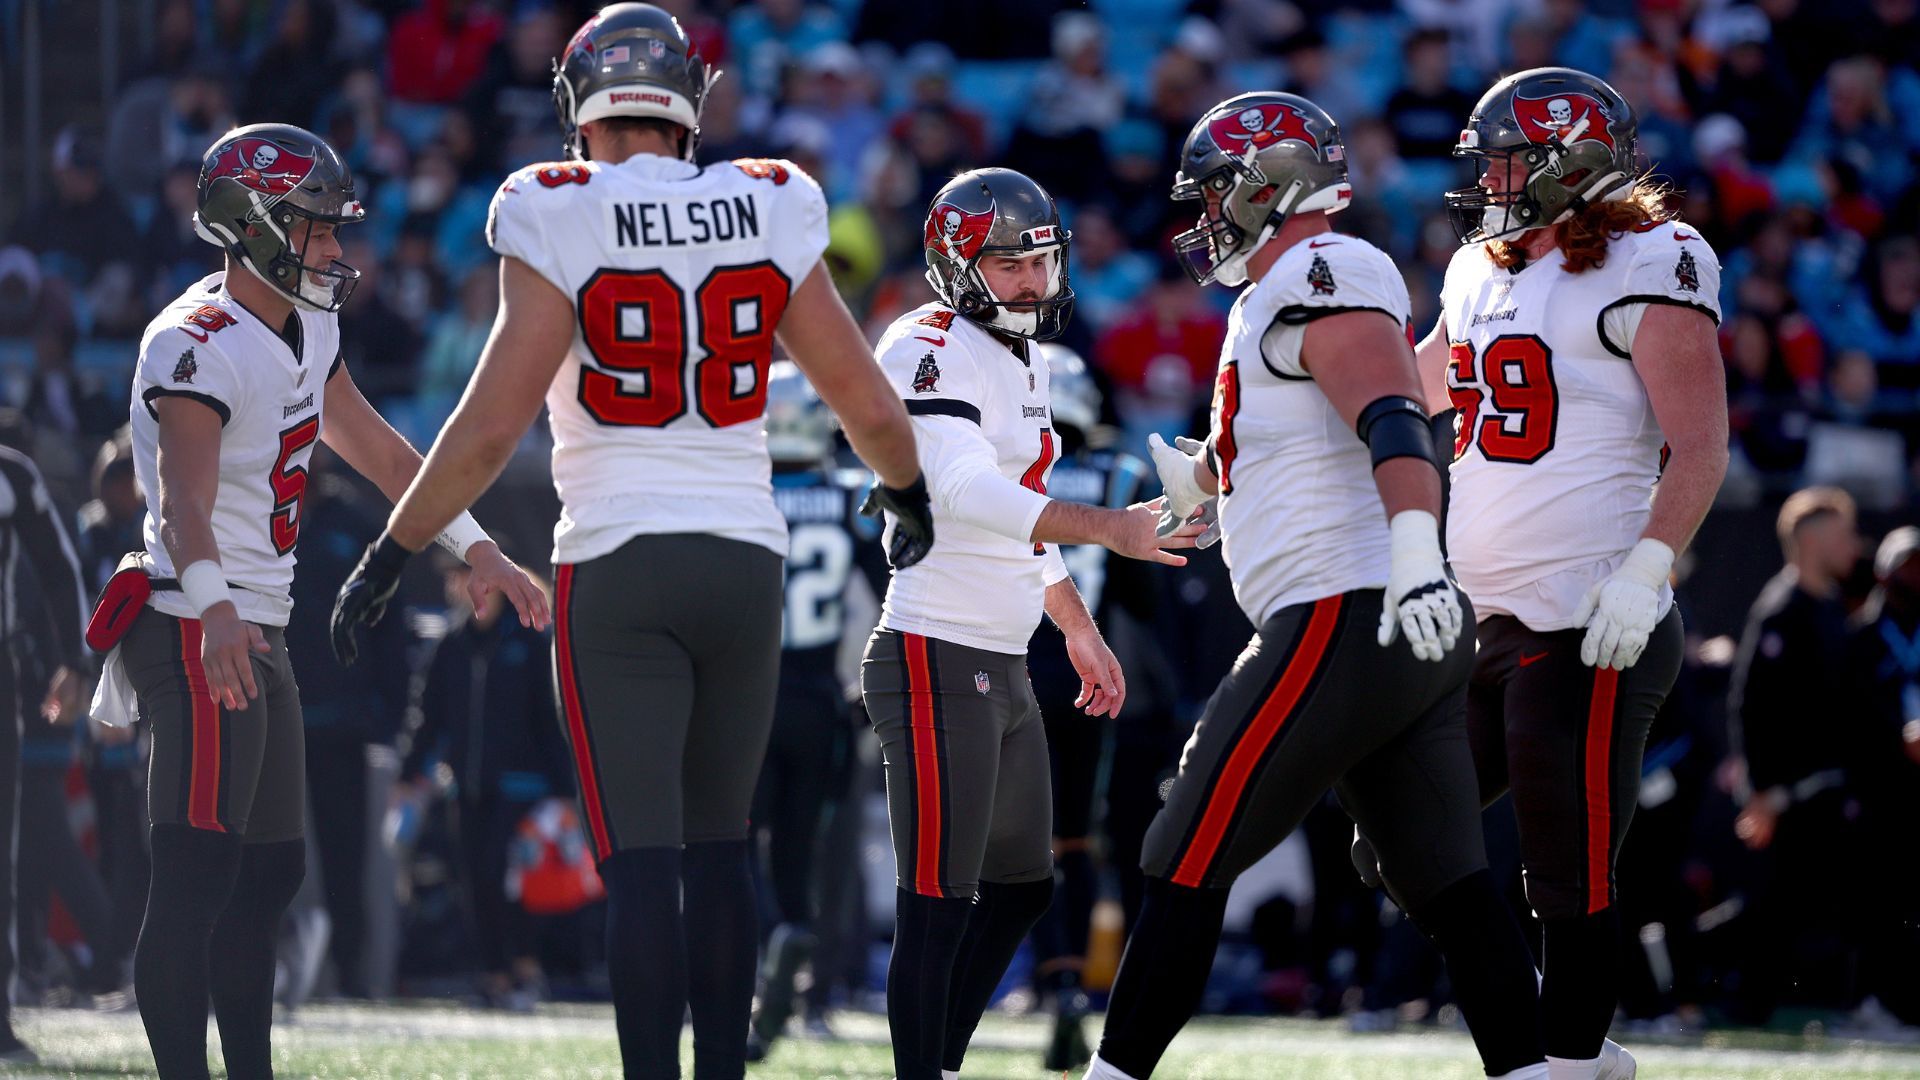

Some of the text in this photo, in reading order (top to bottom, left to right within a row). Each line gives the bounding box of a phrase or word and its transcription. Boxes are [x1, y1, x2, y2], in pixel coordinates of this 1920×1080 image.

[609, 92, 672, 107] BUCCANEERS
[613, 194, 759, 248] NELSON
[577, 259, 791, 428] 98
[1445, 333, 1559, 465] 69
[268, 412, 319, 558] 5
